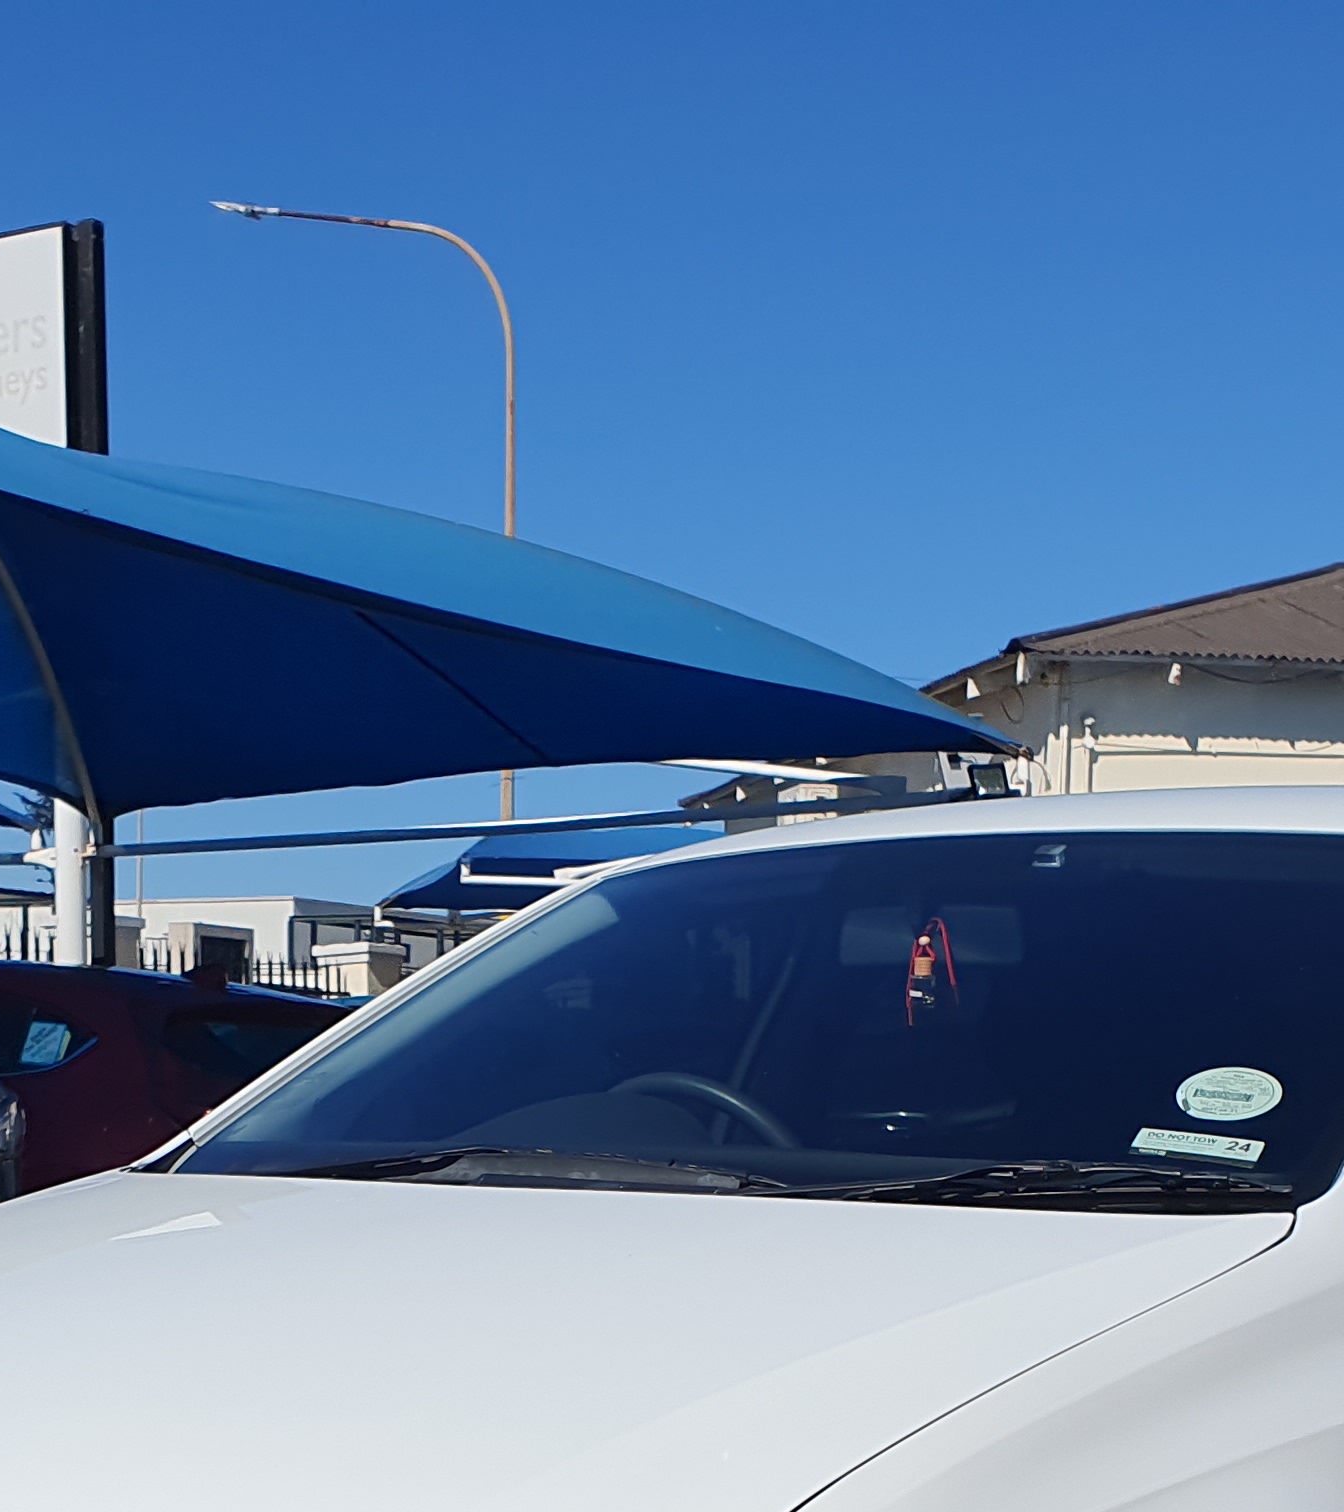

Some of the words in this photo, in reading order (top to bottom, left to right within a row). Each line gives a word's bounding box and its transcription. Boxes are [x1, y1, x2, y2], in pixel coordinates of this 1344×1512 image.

[1147, 1131, 1165, 1139] DO
[1168, 1133, 1191, 1141] NOT
[1192, 1136, 1219, 1144] TOW
[1224, 1140, 1252, 1153] 24
